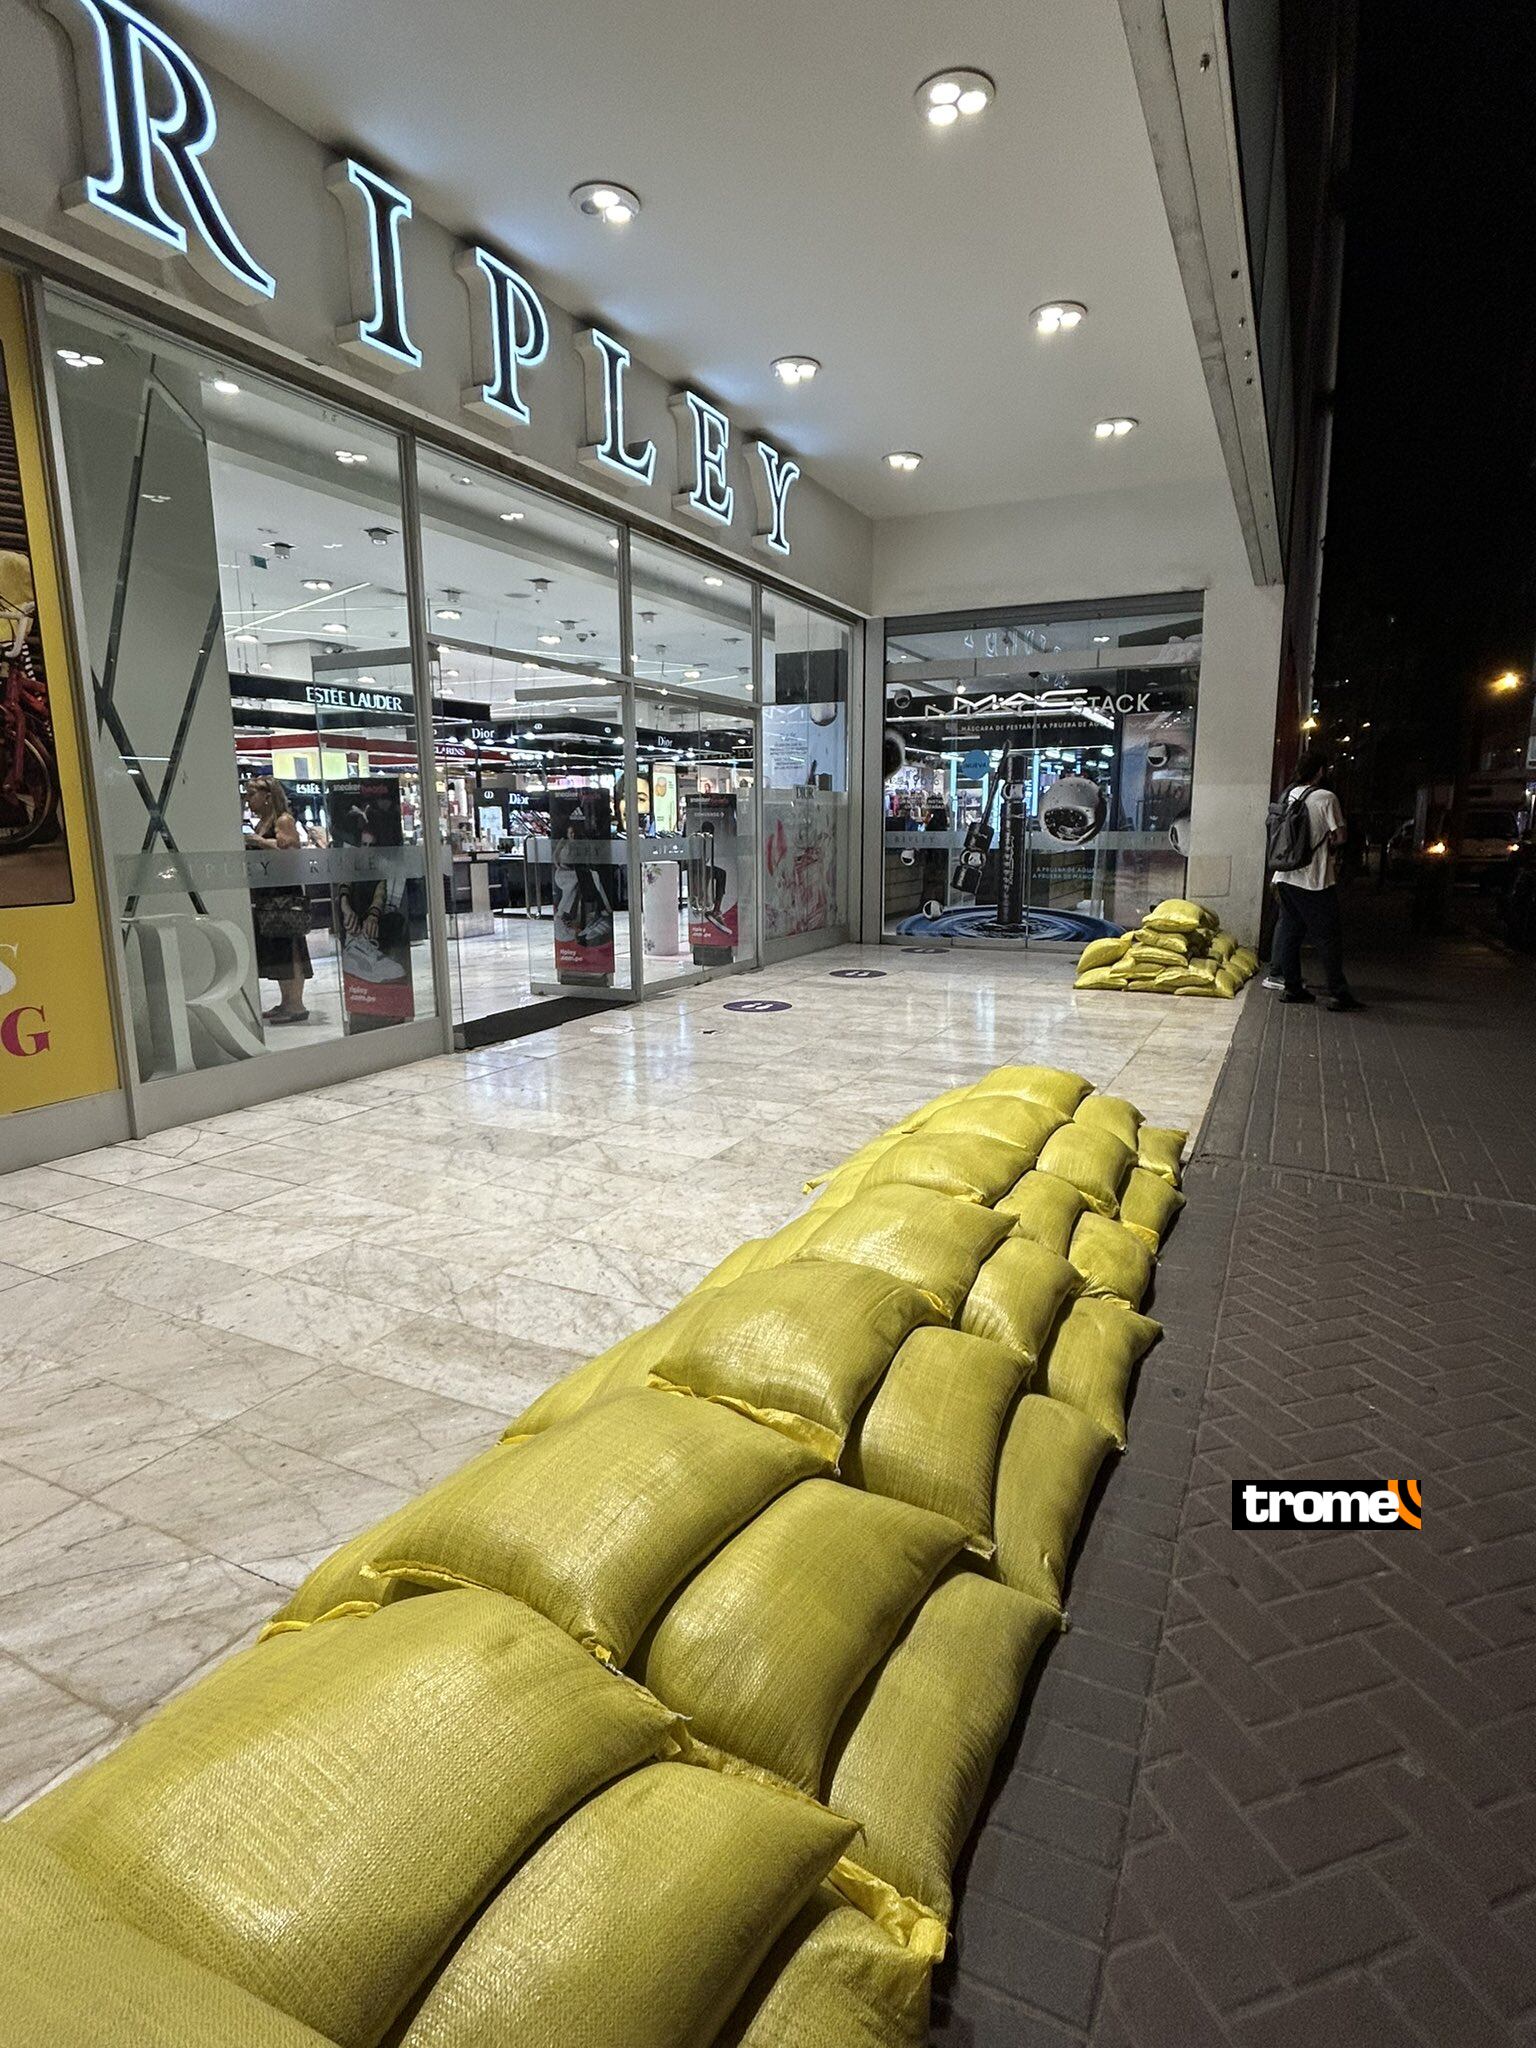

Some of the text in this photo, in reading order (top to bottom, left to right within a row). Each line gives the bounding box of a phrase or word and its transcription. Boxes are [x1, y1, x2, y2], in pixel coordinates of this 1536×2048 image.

[87, 0, 800, 554] RIPLEY
[350, 691, 403, 711] LAUDER
[471, 728, 494, 739] Dior
[657, 735, 673, 748] Dior
[509, 793, 530, 805] Dior
